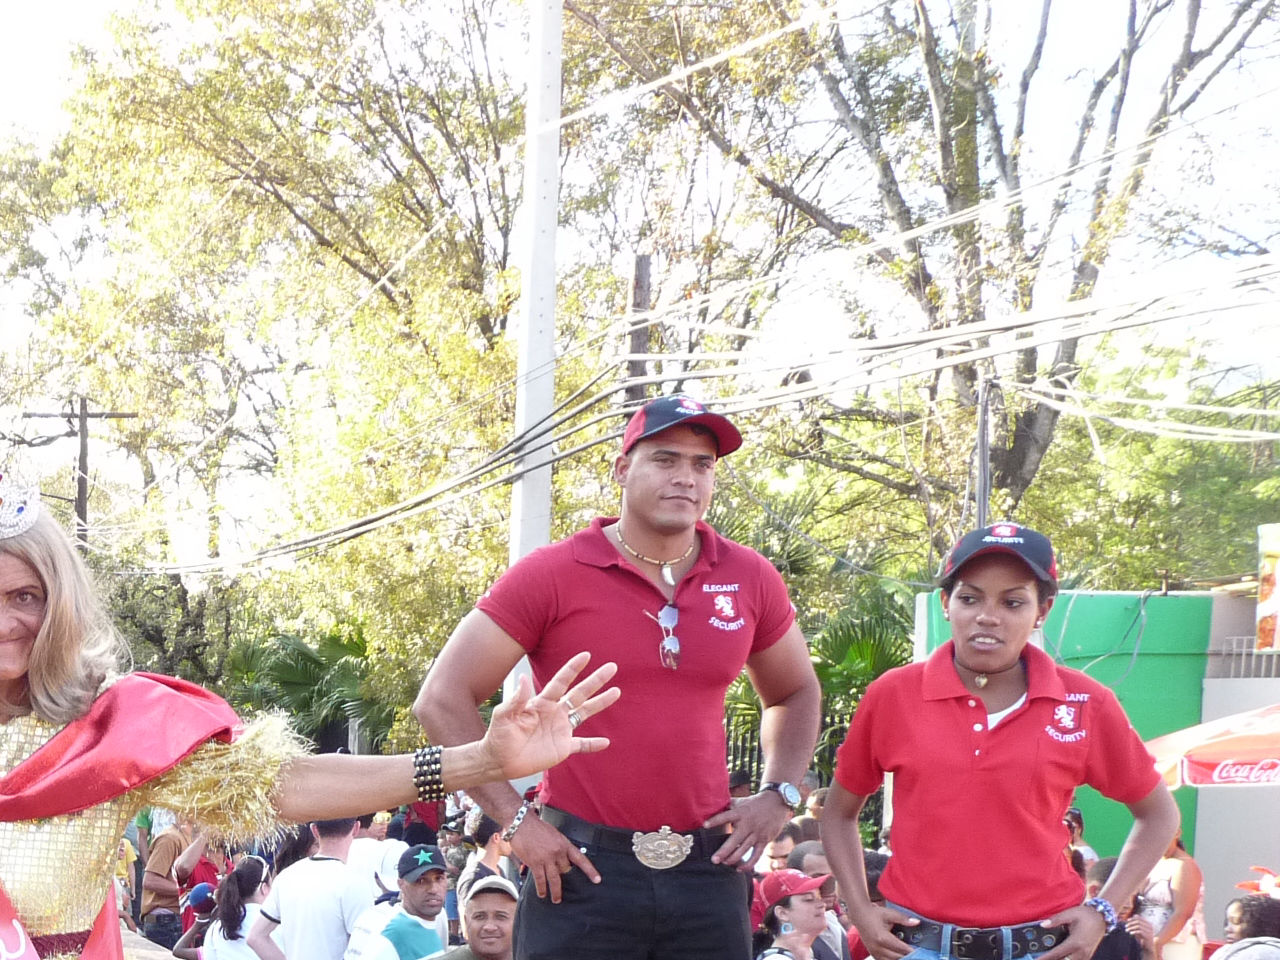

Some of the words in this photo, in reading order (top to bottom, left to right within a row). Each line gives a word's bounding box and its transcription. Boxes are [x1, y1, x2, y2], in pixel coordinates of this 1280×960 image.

[703, 584, 740, 592] ELEGANT
[709, 617, 745, 631] SECURITY
[1045, 726, 1087, 742] SECURITY
